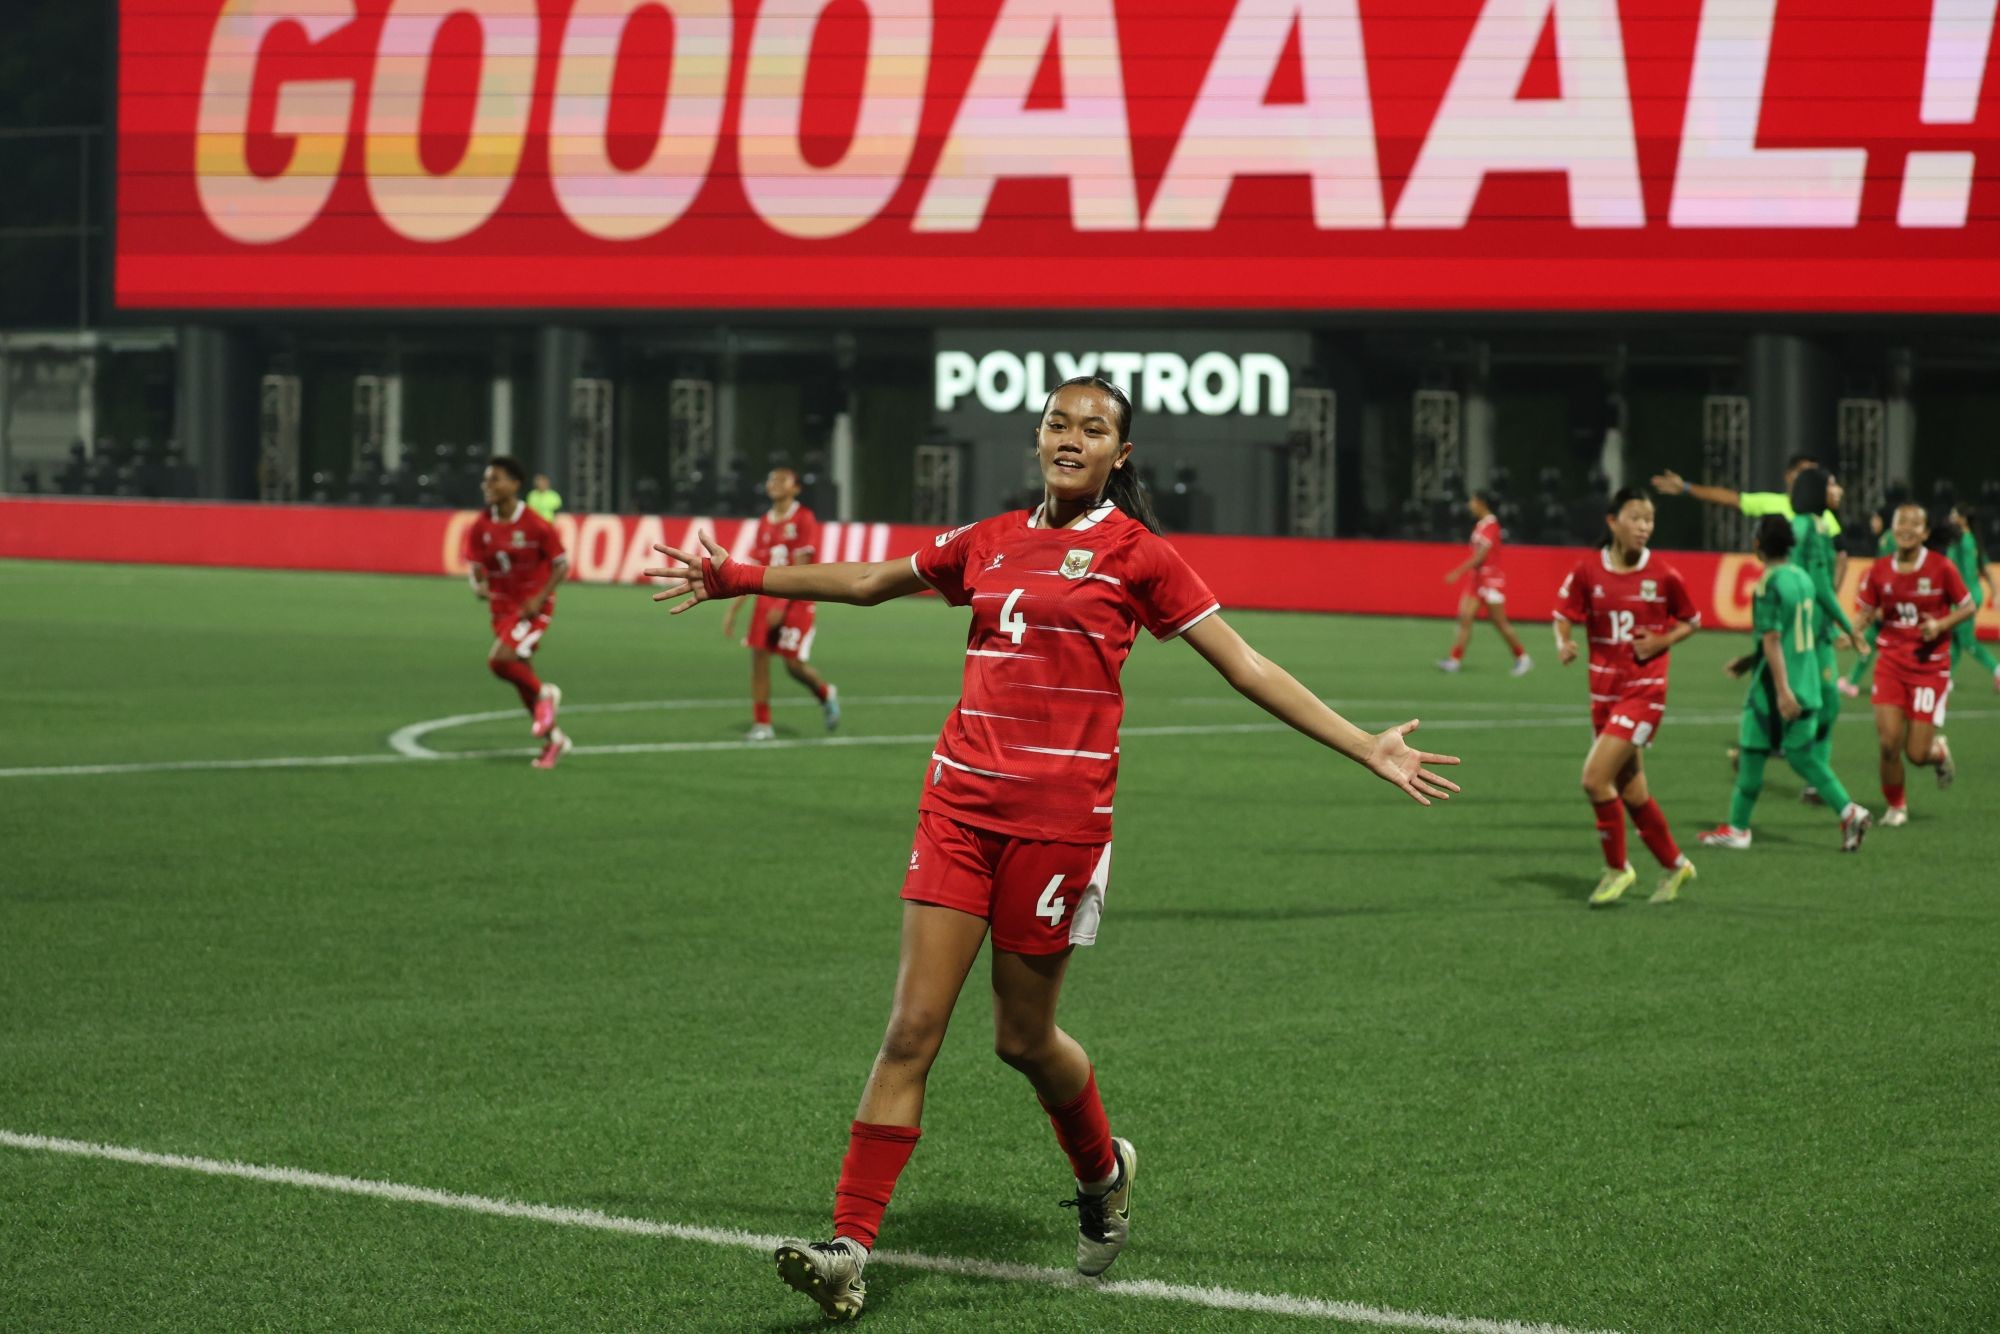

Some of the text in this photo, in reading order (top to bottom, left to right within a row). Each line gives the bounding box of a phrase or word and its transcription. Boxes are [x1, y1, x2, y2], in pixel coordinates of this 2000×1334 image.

[195, 0, 1998, 243] GOOOAAAL!
[999, 588, 1027, 644] 4
[1608, 610, 1635, 645] 12
[1913, 687, 1936, 713] 10
[1035, 873, 1066, 927] 4
